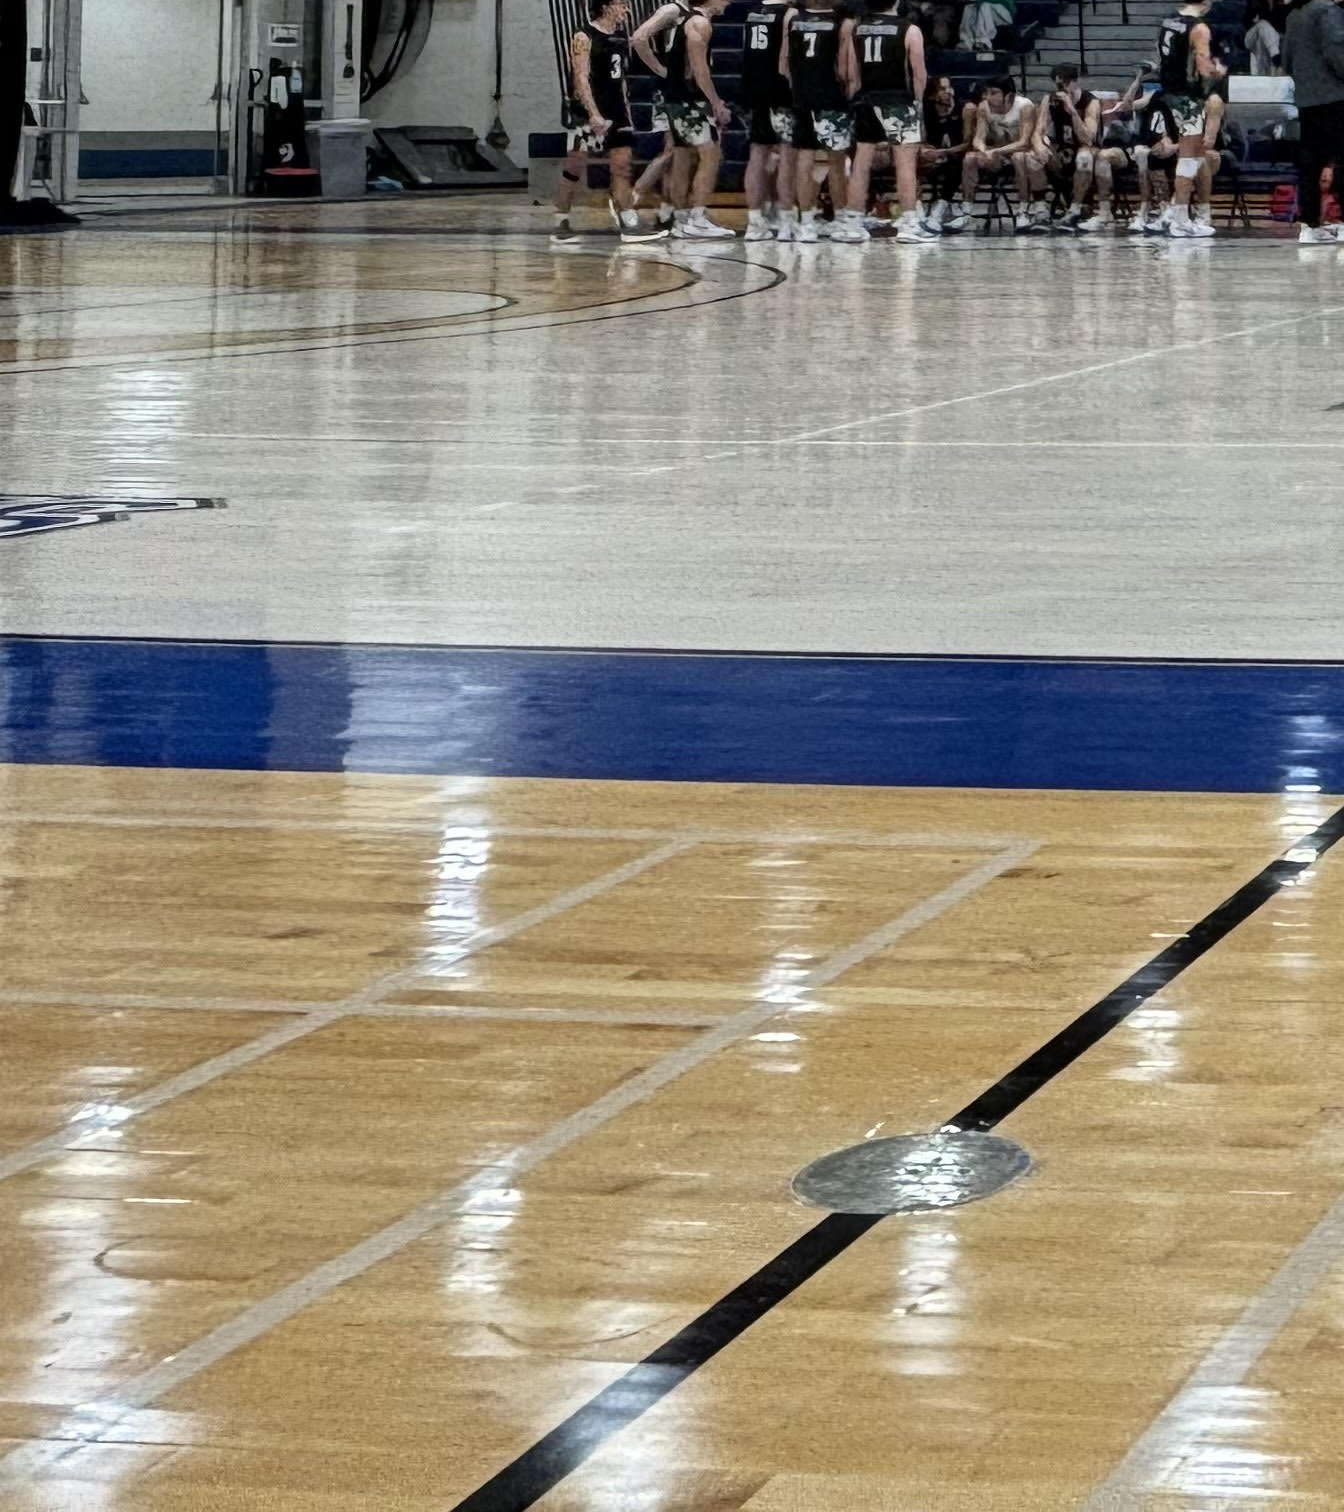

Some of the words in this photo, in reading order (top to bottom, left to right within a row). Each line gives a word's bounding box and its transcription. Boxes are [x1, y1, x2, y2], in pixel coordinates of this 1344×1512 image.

[803, 32, 817, 58] 7
[864, 36, 882, 63] 11
[610, 53, 622, 79] 3
